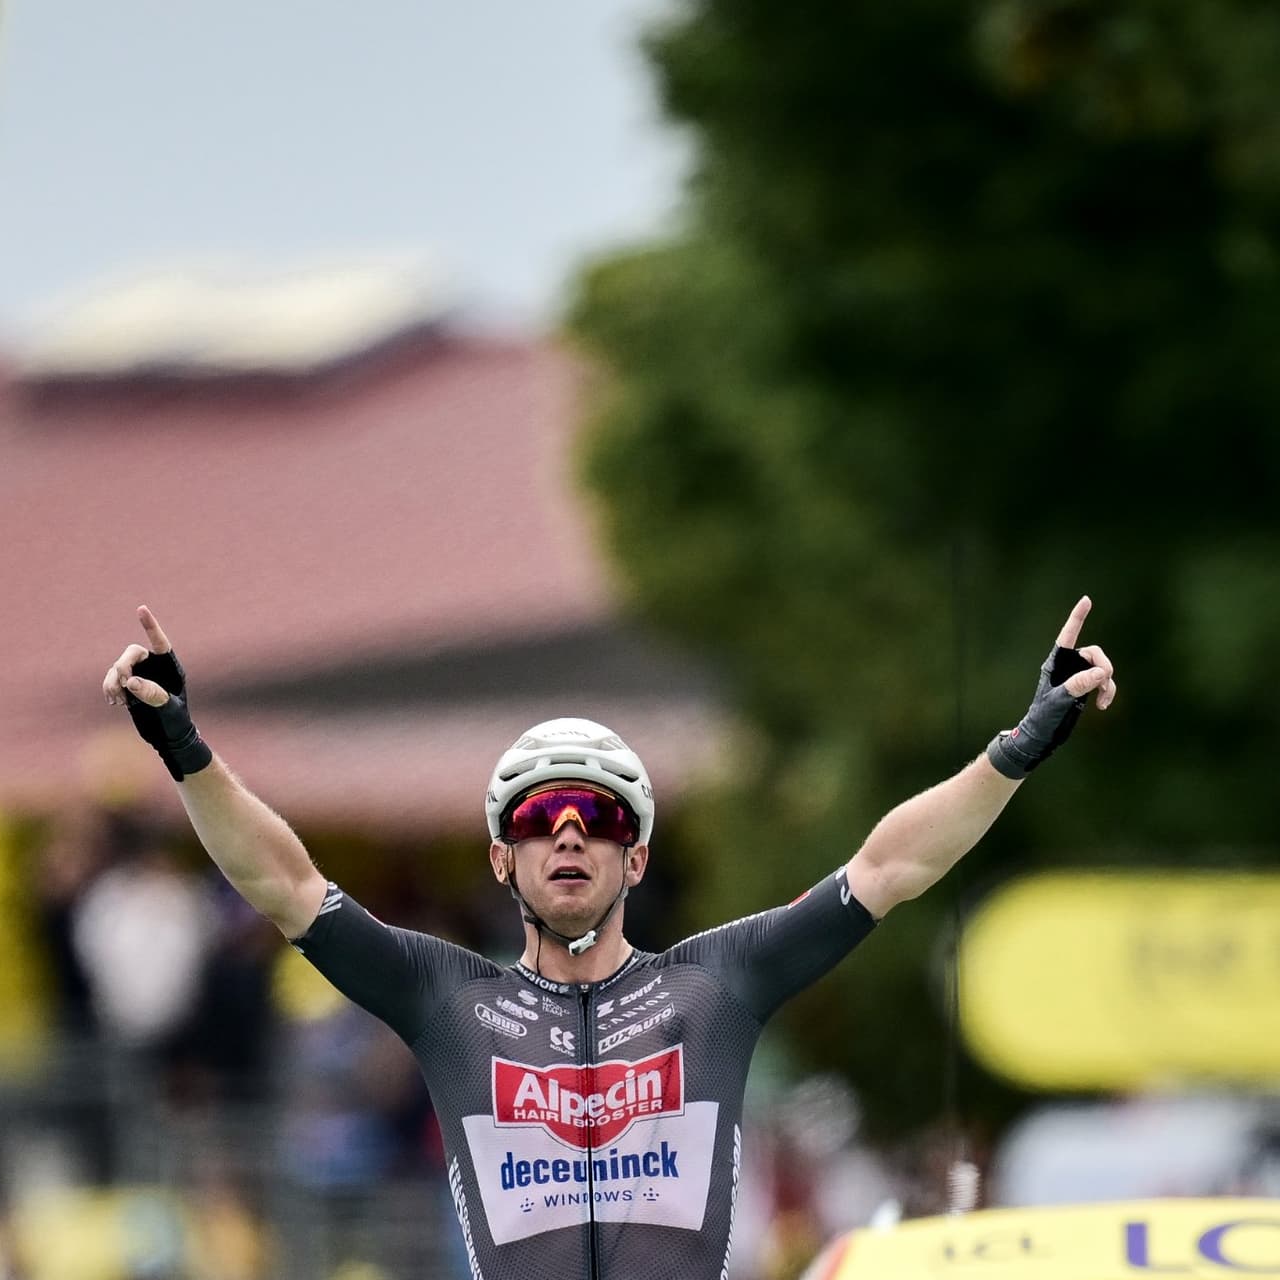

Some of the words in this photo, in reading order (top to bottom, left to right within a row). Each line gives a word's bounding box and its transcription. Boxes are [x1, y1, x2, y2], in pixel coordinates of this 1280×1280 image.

[620, 975, 663, 1006] ZWIFT
[481, 1008, 521, 1033] ABUS
[598, 992, 670, 1030] CANYON
[600, 1006, 673, 1051] LUXAUTO
[513, 1069, 663, 1124] Alpecin
[514, 1109, 560, 1123] HAIR
[573, 1099, 663, 1128] BOOSTER
[500, 1141, 679, 1191] deceuninck
[543, 1190, 633, 1208] WINDOWS
